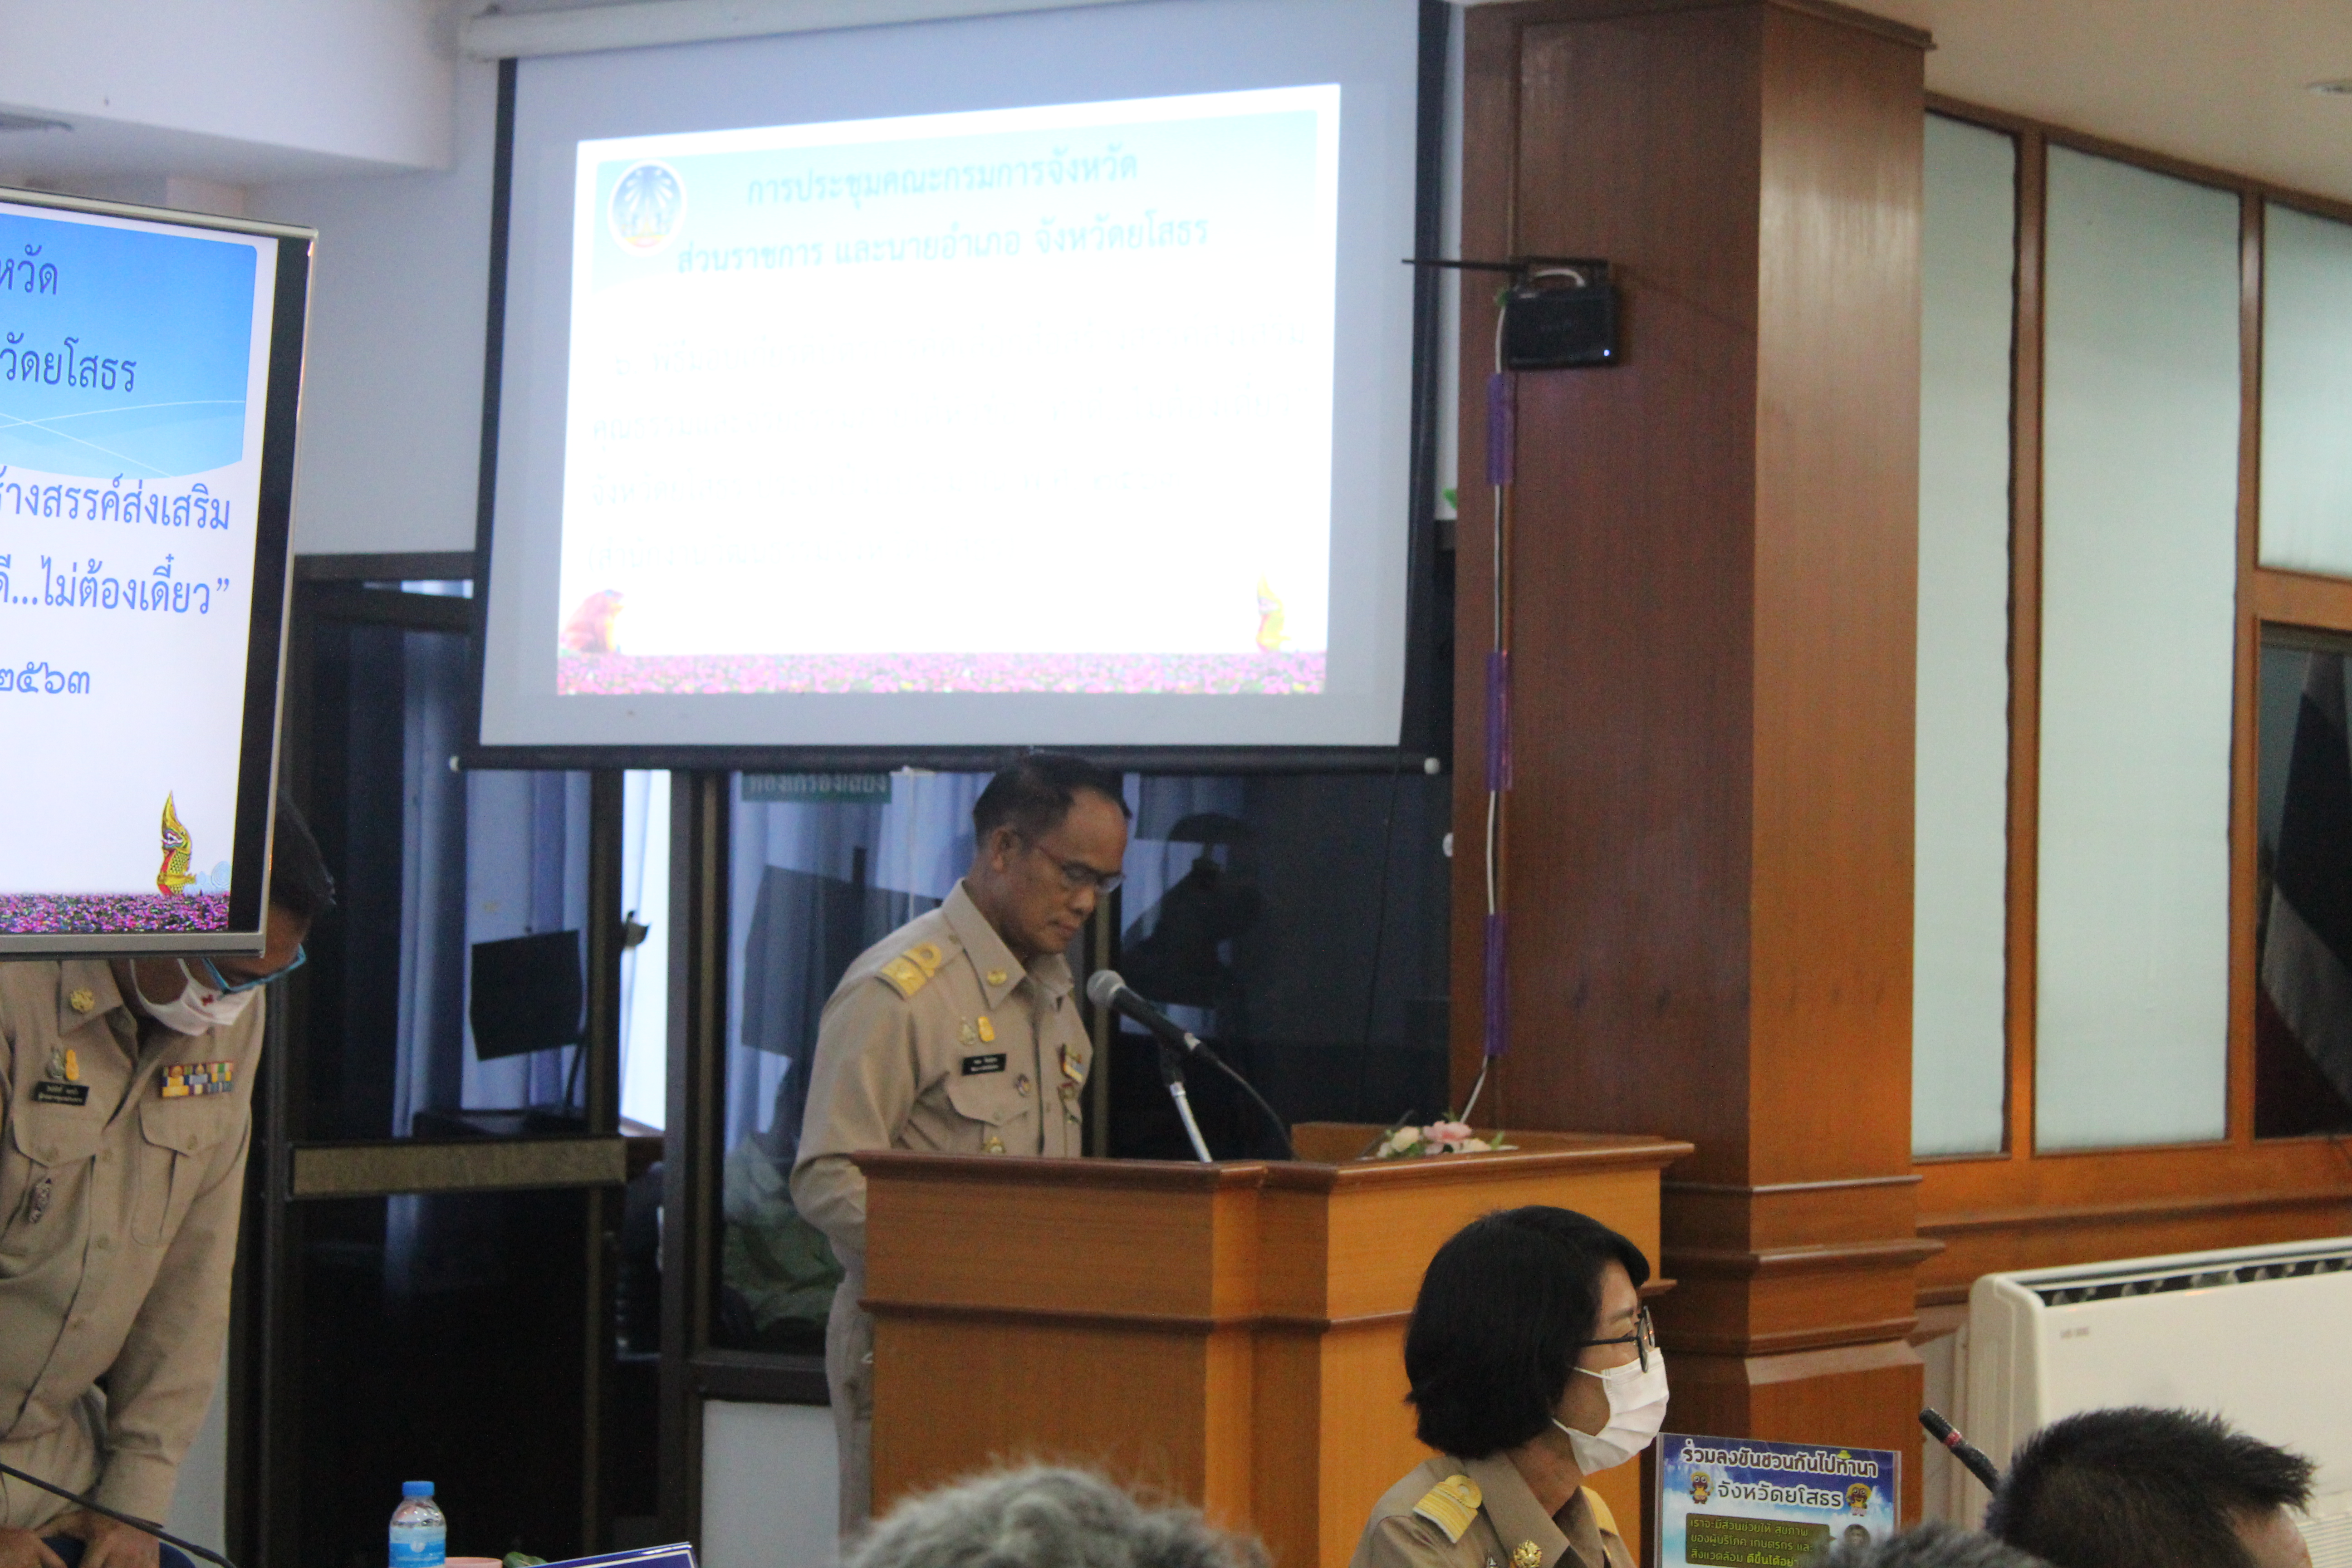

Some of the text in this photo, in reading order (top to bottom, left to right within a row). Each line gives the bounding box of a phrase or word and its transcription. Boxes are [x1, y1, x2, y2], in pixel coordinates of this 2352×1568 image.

[678, 211, 1208, 273] ส่วนราชการ และนายอำเภอ จังหวัดยโสธร
[0, 331, 136, 392] วัดยโสธร
[0, 465, 230, 529] างสรรค์ส่งเสริม
[1718, 1480, 1843, 1509] จังหวัดยโสธร
